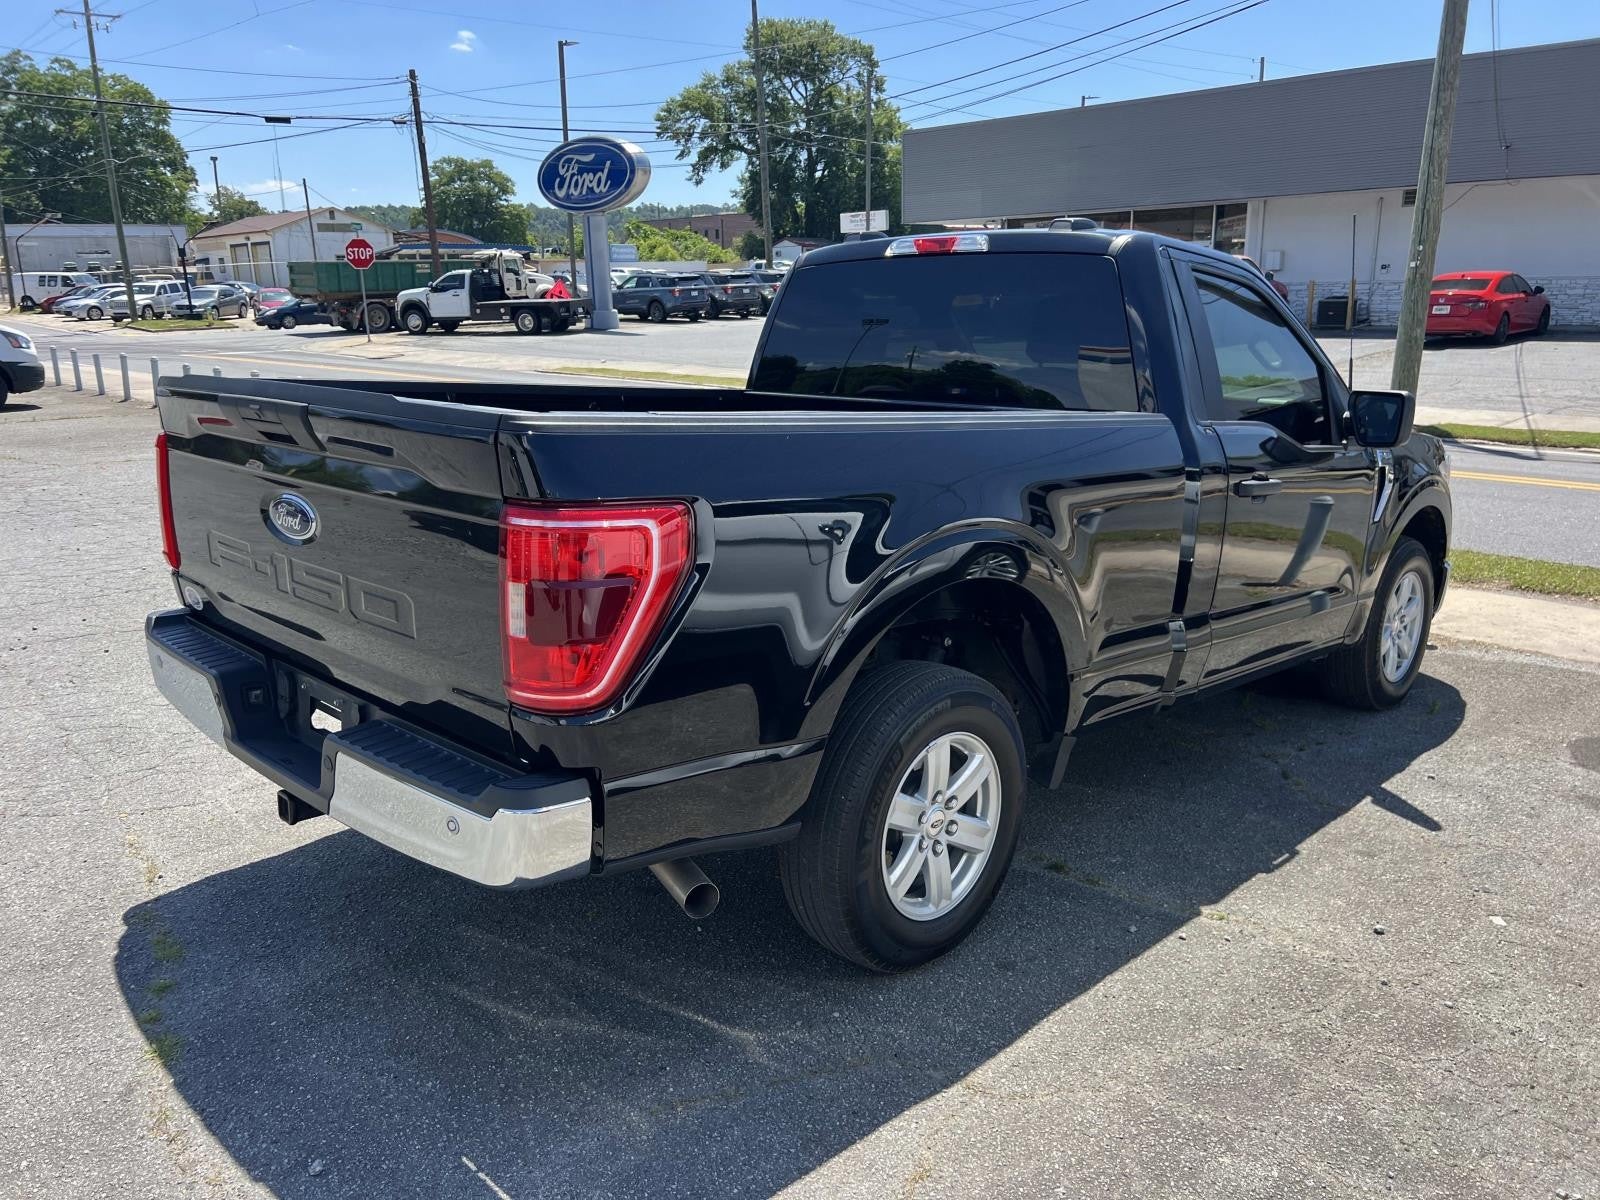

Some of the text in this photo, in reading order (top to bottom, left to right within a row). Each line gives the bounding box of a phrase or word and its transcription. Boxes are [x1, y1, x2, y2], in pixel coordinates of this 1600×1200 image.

[555, 153, 611, 198] Ford
[347, 247, 372, 259] STOP
[276, 502, 301, 530] Ford
[208, 530, 416, 639] F-150
